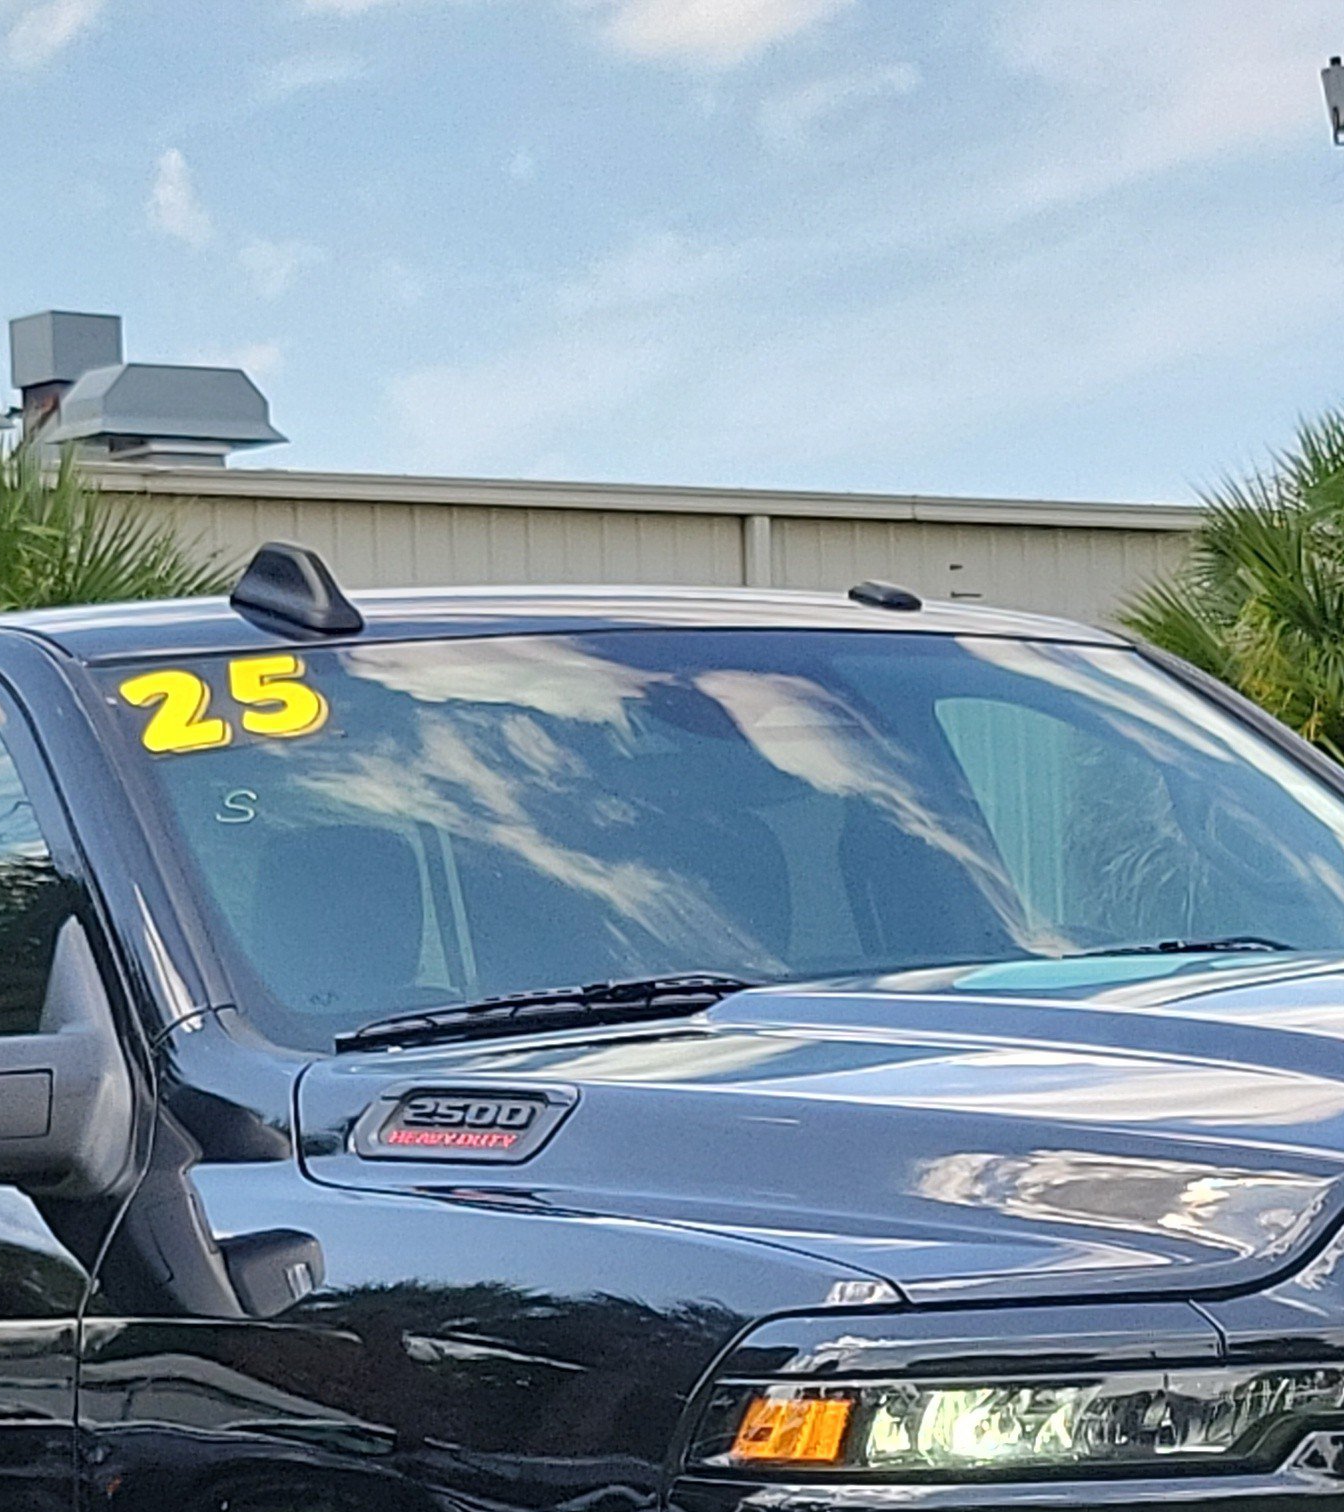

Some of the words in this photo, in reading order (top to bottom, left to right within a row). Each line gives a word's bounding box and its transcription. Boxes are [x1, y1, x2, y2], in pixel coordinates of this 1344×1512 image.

[119, 653, 331, 756] 25
[402, 1101, 534, 1130] 2500
[387, 1128, 457, 1147] HEAVY
[454, 1130, 519, 1149] DUTY
